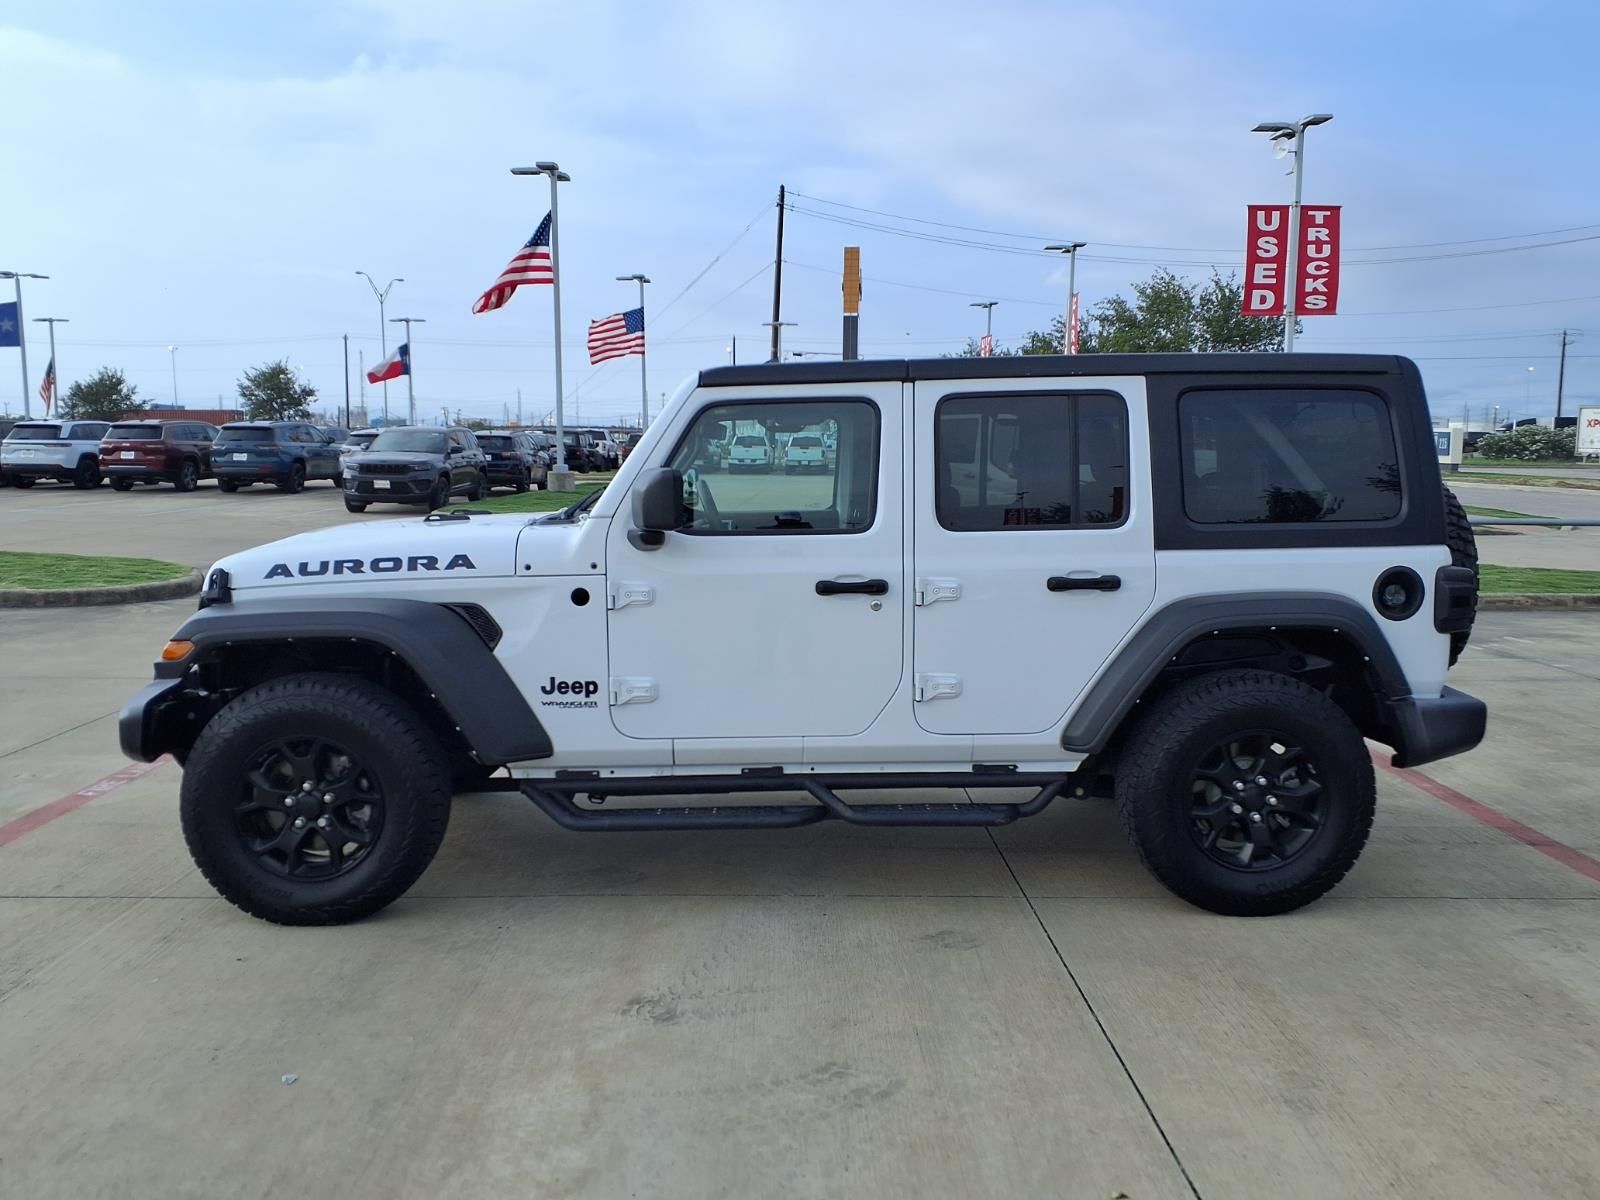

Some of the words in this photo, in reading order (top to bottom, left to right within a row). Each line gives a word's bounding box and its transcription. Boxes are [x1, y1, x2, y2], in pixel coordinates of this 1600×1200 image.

[1250, 210, 1281, 310] USED
[1304, 210, 1331, 309] TRUCKS
[1586, 418, 1600, 428] XP
[263, 554, 477, 579] AURORA
[540, 676, 599, 698] Jeep
